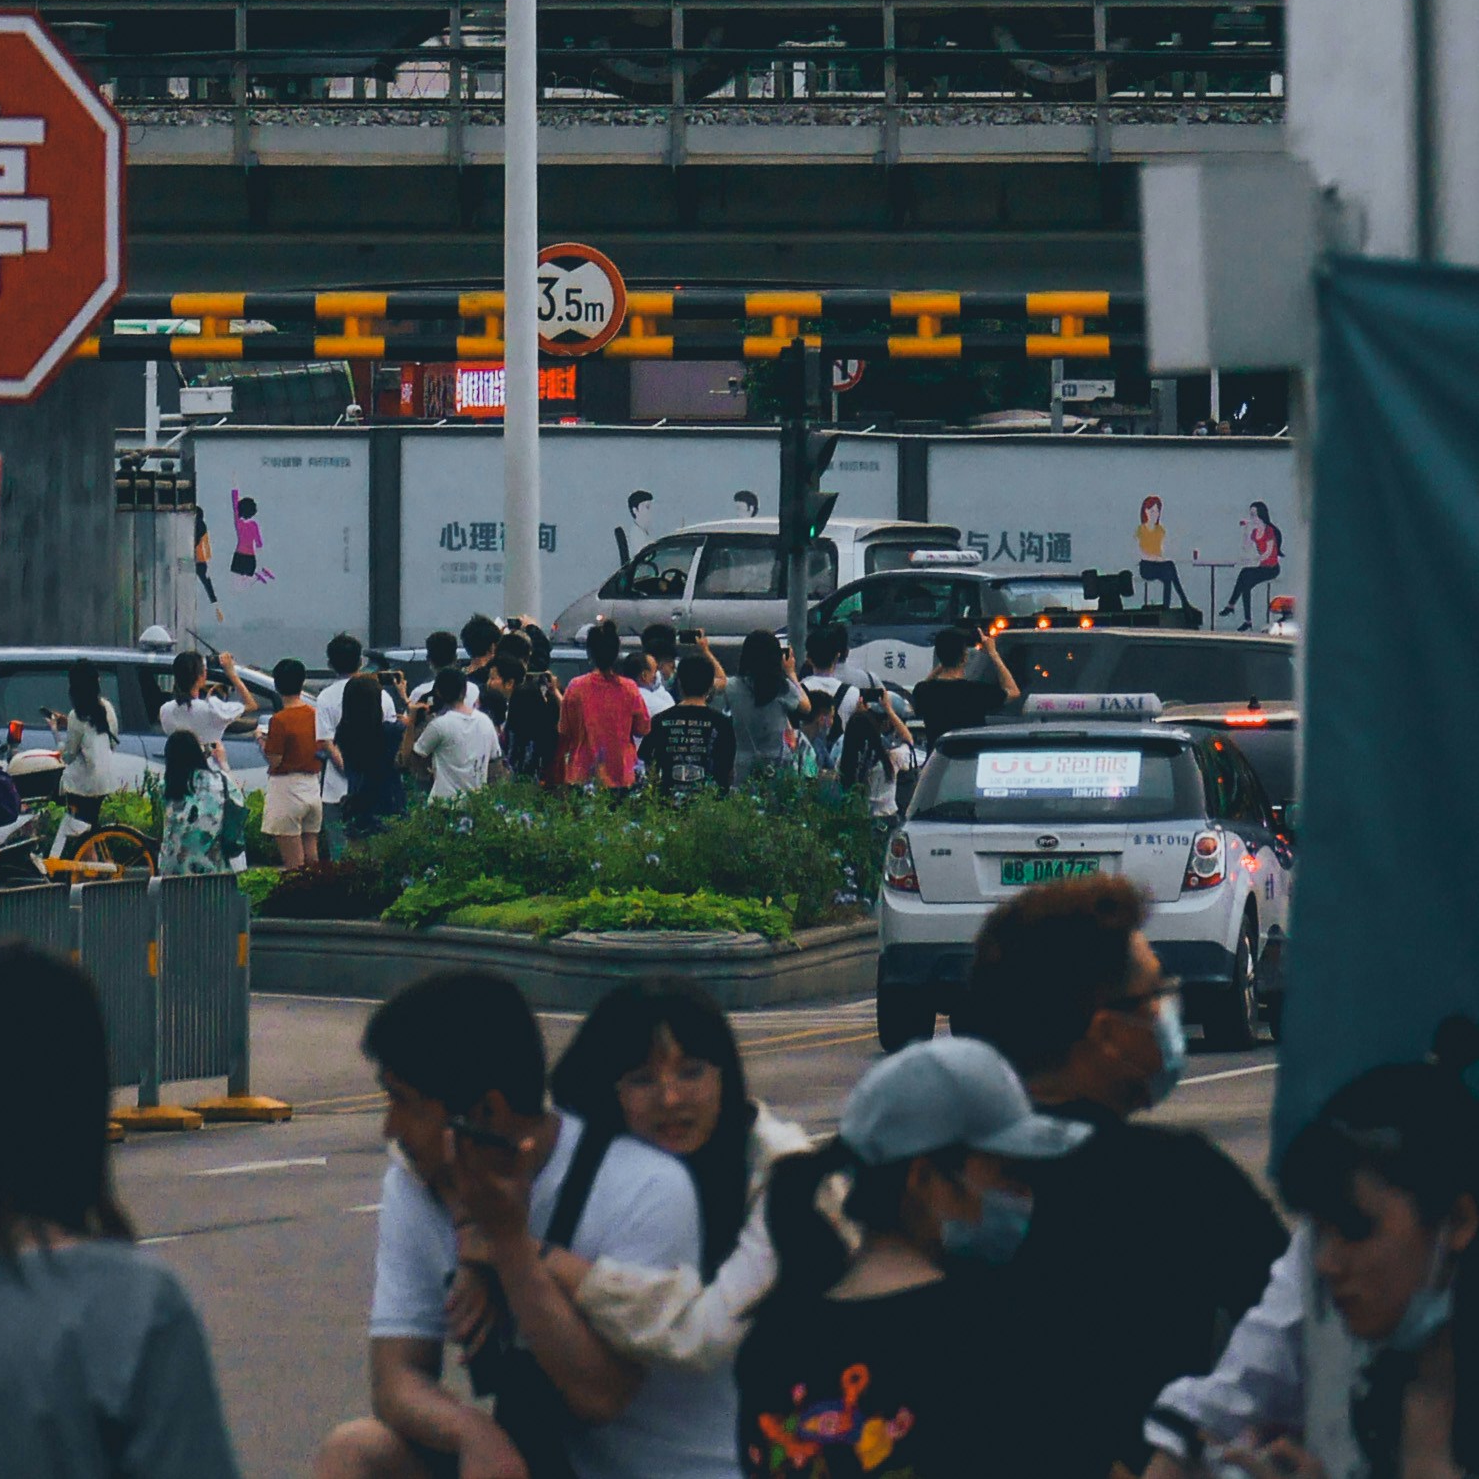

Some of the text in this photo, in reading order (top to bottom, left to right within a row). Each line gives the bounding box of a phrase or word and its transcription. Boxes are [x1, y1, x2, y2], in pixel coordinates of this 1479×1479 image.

[537, 276, 605, 323] 3.5m
[438, 520, 558, 553] 心理询
[966, 530, 1072, 563] 与人沟通
[1097, 696, 1144, 711] TAXI
